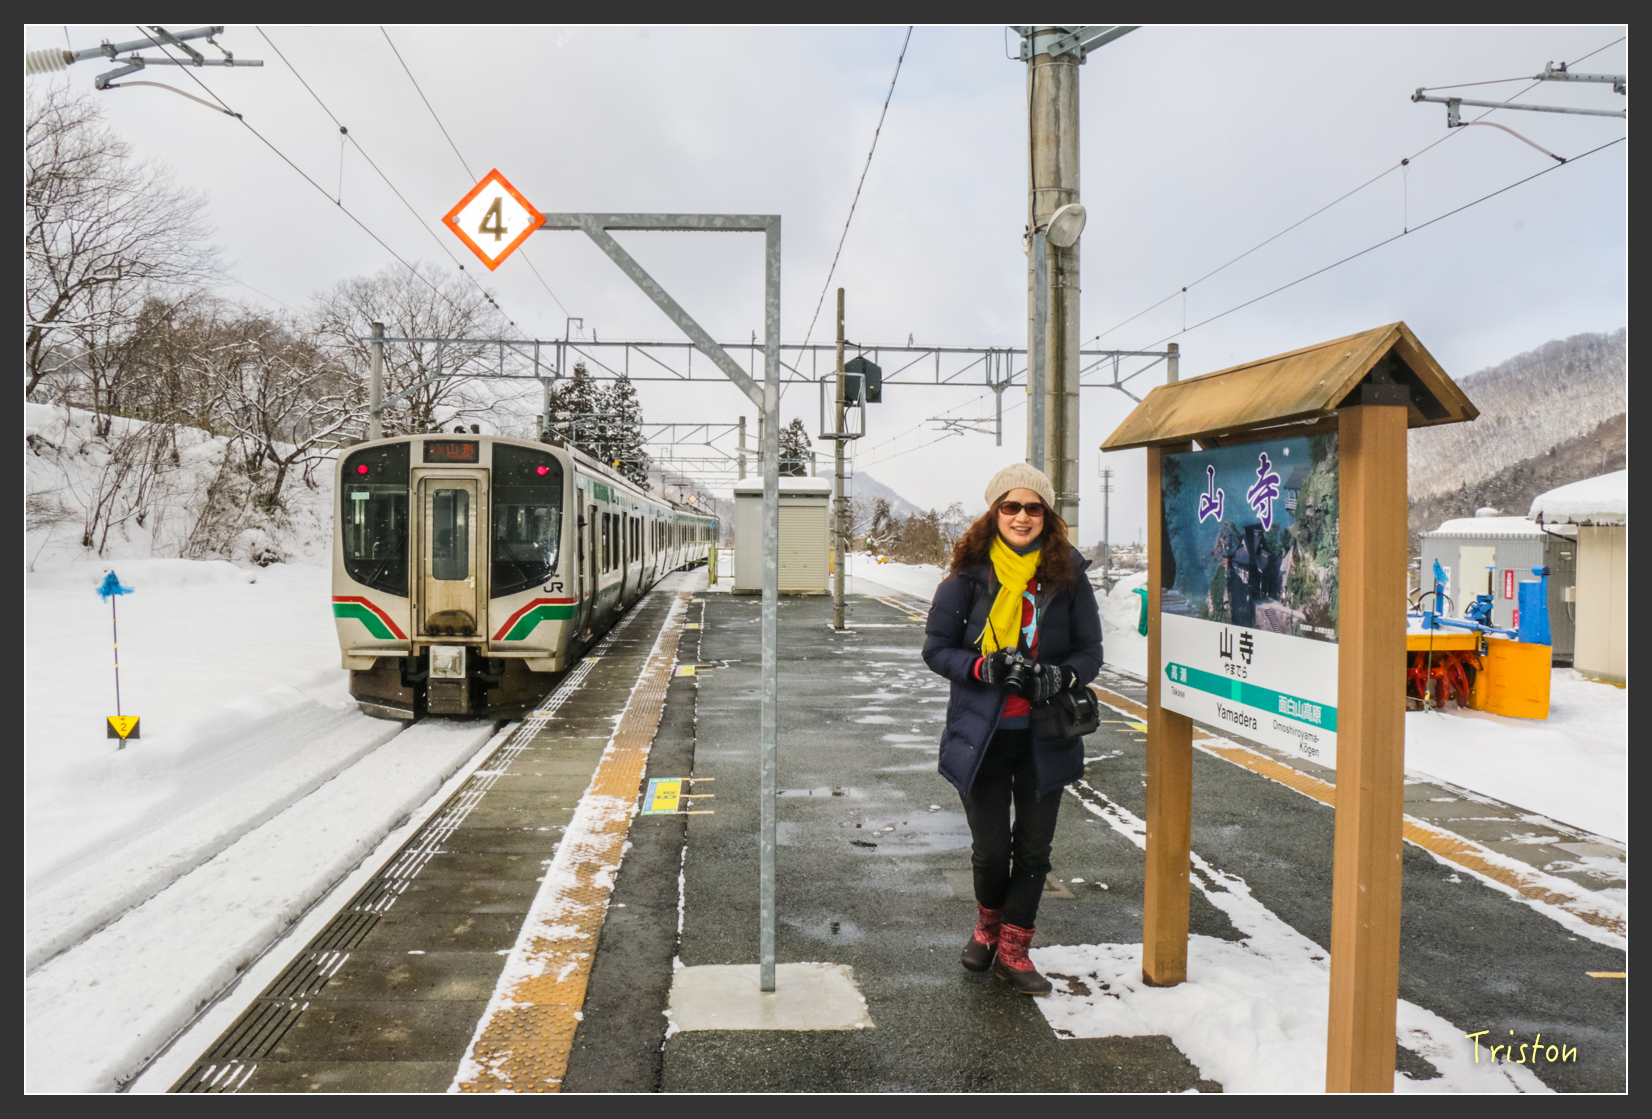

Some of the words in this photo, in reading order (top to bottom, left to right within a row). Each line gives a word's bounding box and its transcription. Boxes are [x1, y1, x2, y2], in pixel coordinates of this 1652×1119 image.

[478, 196, 508, 241] 4
[1198, 452, 1281, 532] 山寺
[543, 582, 563, 593] JR
[1219, 627, 1253, 665] 山寺
[1224, 662, 1247, 679] やまでら
[1171, 686, 1185, 699] Takase
[1216, 702, 1258, 730] Yamadera
[1278, 695, 1322, 724] 面白山高原
[120, 723, 127, 732] 2
[1273, 719, 1320, 743] Omoshiroyama-
